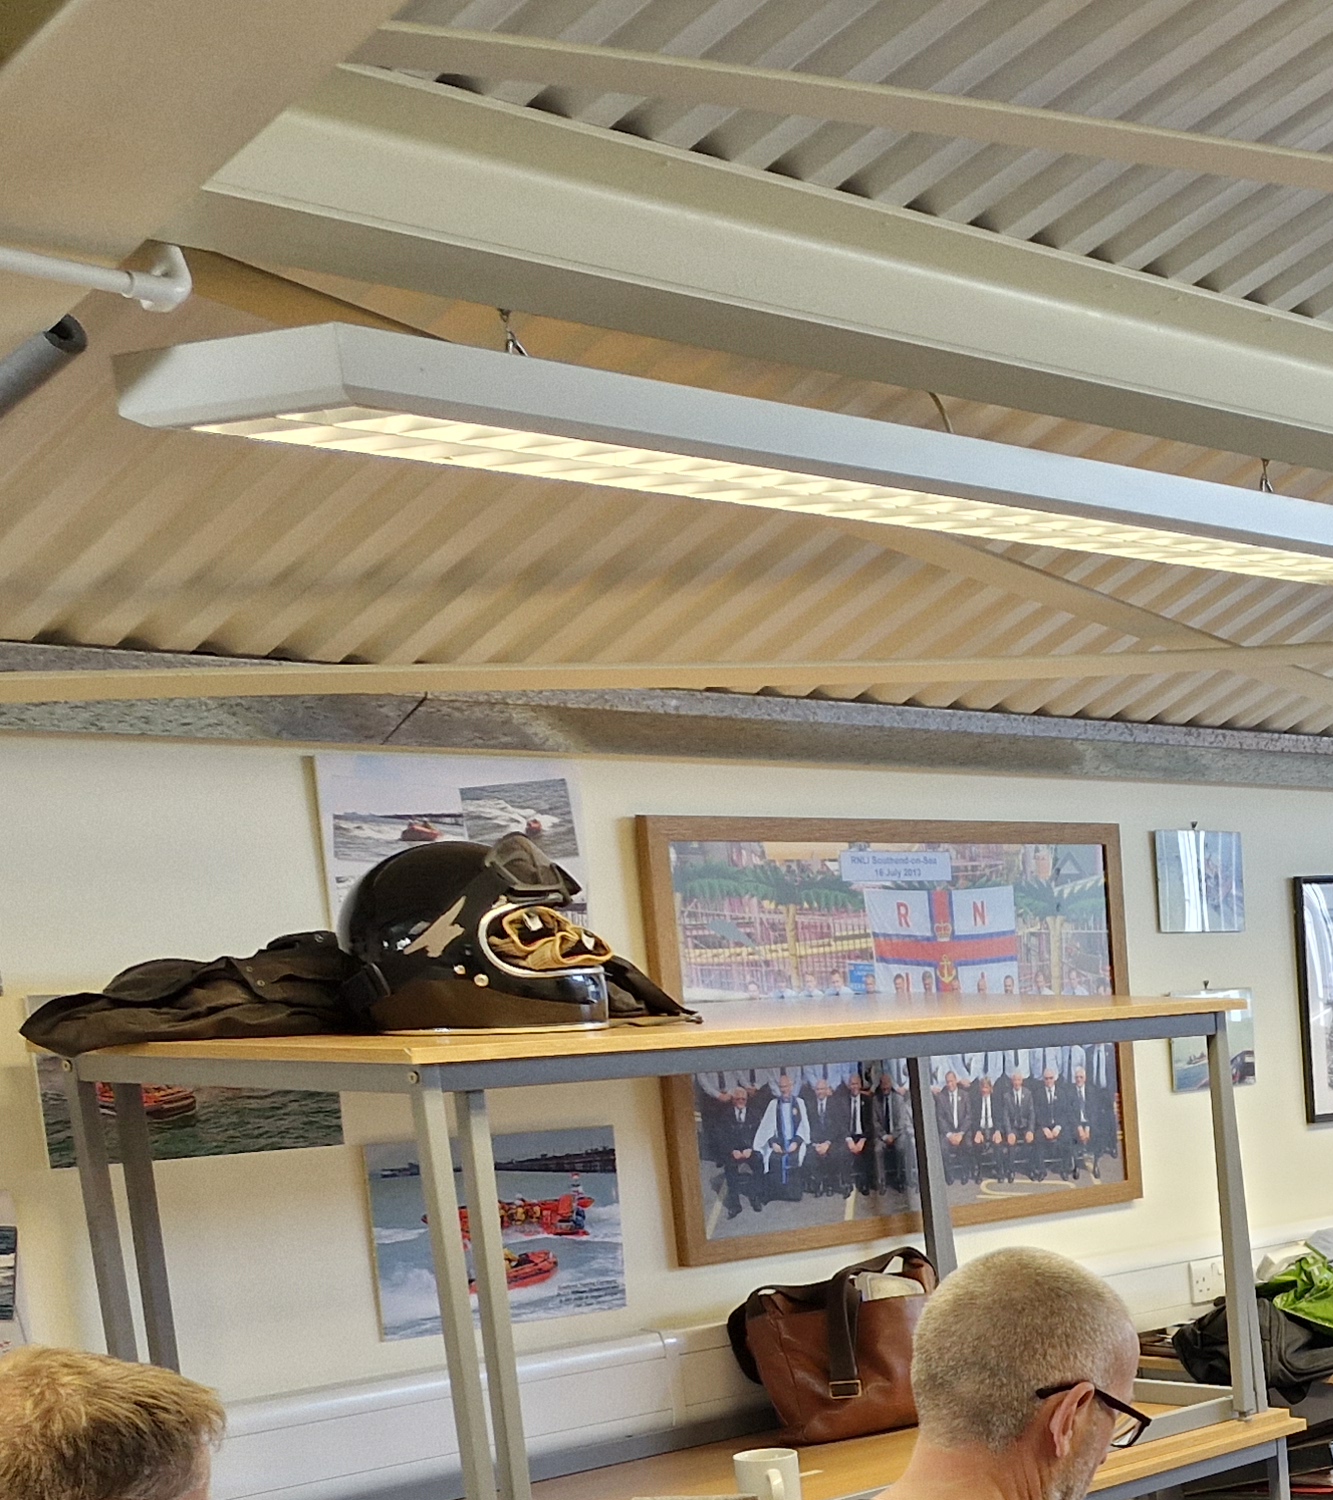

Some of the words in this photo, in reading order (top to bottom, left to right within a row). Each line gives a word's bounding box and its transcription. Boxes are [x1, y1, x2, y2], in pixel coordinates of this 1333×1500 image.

[885, 868, 901, 878] July
[896, 901, 910, 928] R
[972, 900, 987, 927] N
